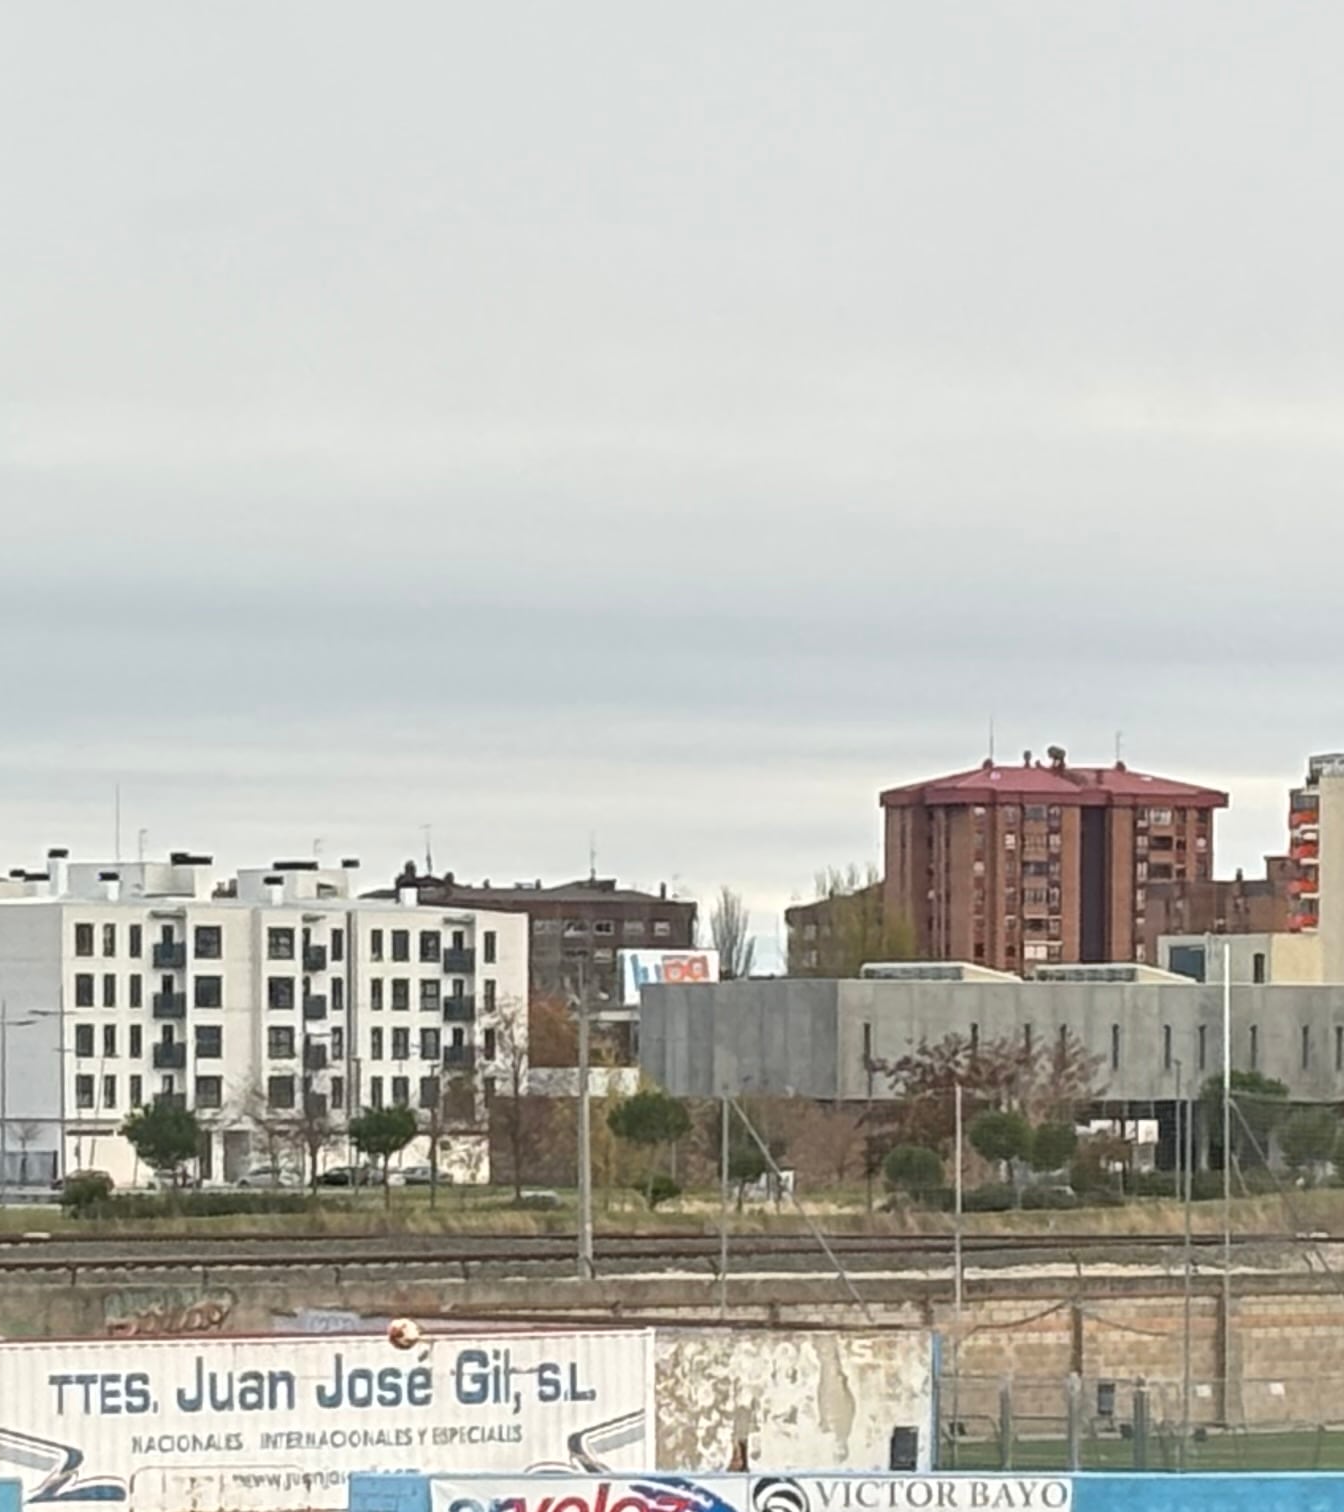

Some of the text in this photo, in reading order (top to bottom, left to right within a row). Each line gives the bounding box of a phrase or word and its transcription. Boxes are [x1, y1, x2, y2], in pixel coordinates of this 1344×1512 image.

[176, 1356, 295, 1412] Juan
[316, 1350, 432, 1408] José
[455, 1349, 522, 1414] Gil,
[131, 1432, 244, 1454] NACIONALES
[417, 1428, 428, 1447] Y
[814, 1481, 1068, 1509] VICTOR BAYO
